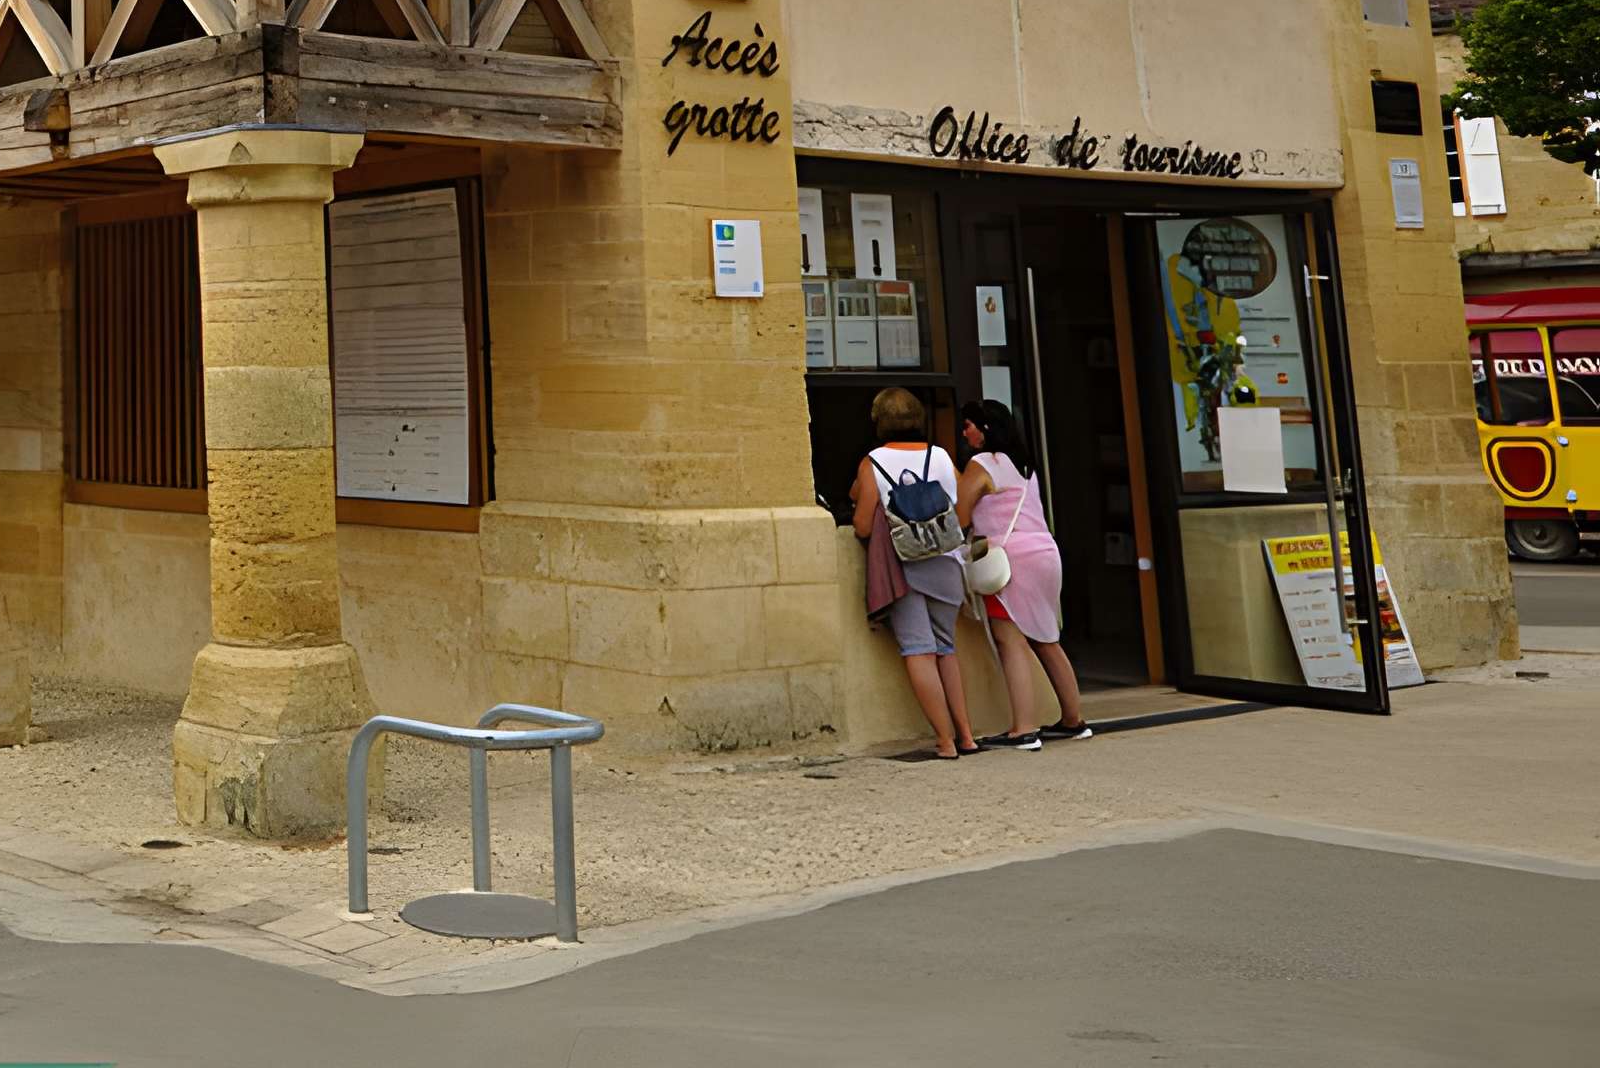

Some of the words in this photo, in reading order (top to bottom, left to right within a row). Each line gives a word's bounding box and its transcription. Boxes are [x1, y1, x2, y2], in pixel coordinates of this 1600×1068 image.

[661, 10, 780, 78] Accès
[662, 97, 781, 157] grotte
[929, 105, 1031, 164] Office
[1056, 116, 1100, 170] de
[1121, 133, 1243, 179] tourisme
